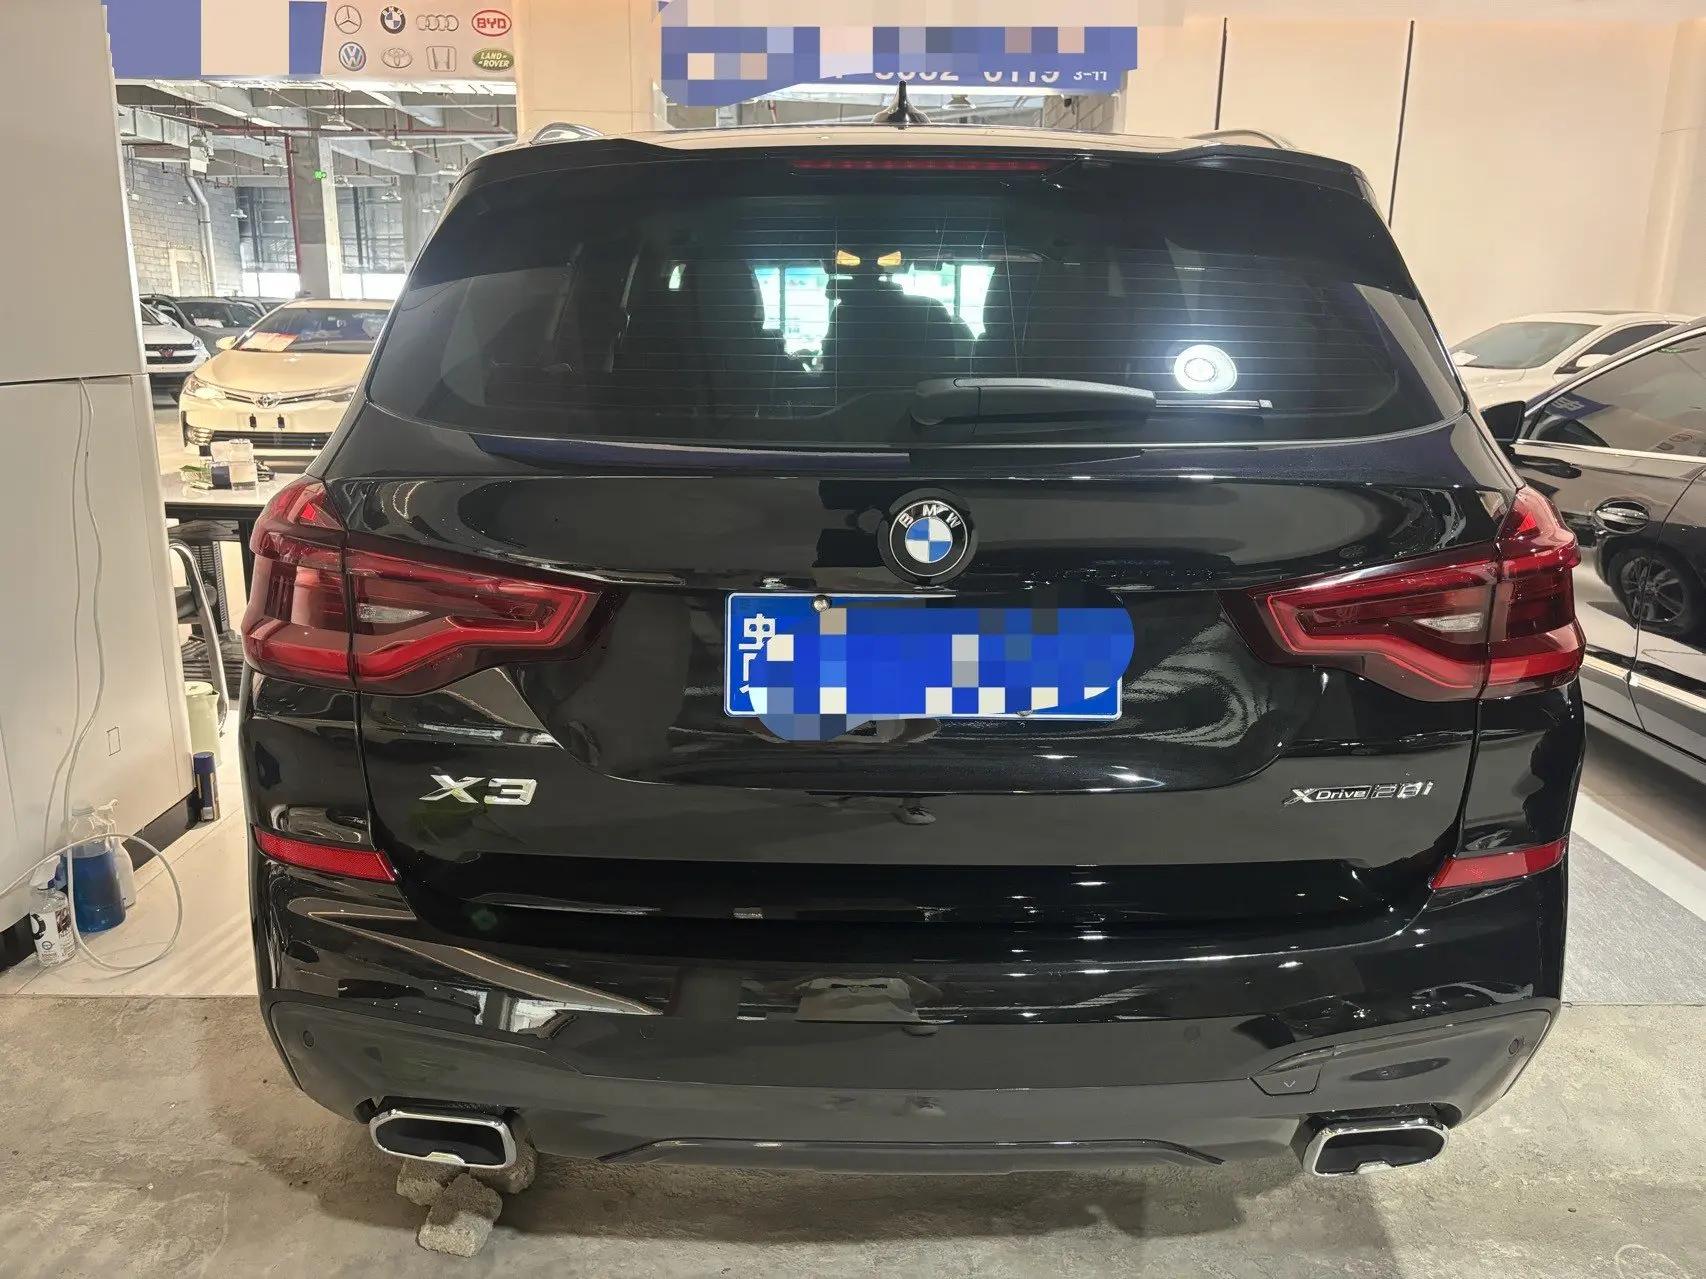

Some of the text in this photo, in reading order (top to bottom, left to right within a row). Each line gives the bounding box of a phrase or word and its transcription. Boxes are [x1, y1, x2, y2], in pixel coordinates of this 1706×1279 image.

[477, 17, 507, 29] BYD
[480, 52, 502, 60] LAND
[483, 60, 510, 68] ROVER
[898, 504, 961, 529] BMW
[418, 774, 538, 806] X3
